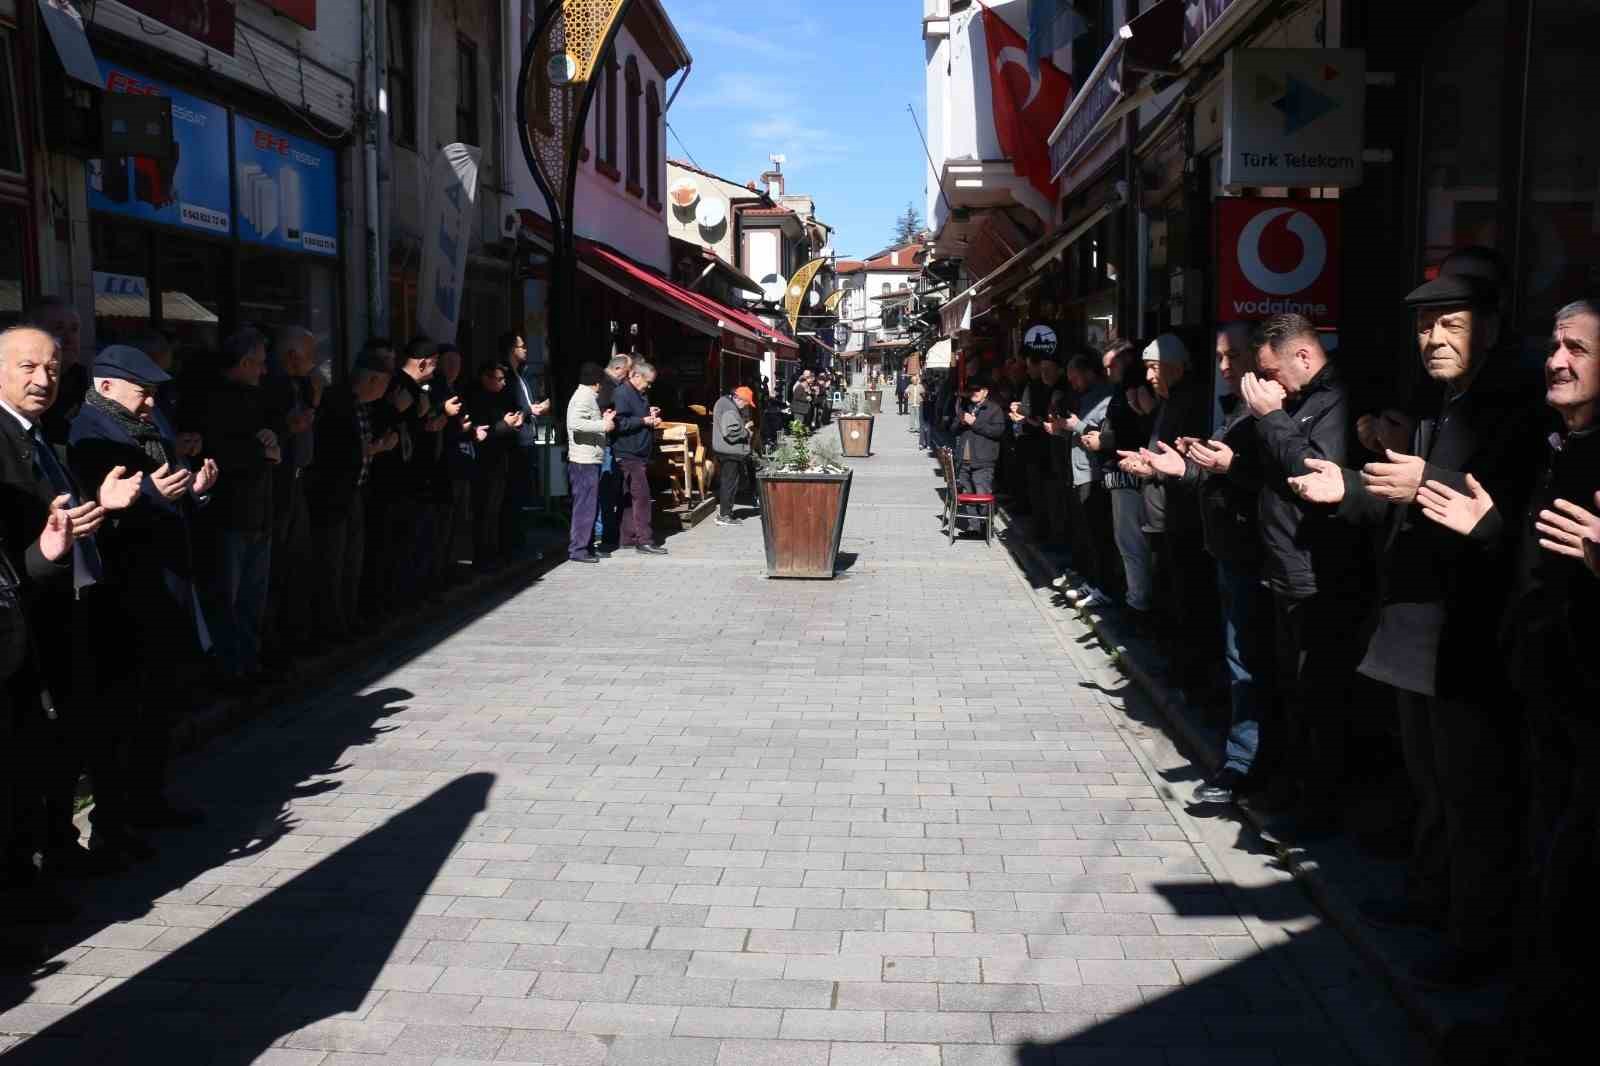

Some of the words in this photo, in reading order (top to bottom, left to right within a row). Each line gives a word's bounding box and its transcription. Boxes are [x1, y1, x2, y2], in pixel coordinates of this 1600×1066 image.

[1241, 152, 1277, 168] Türk
[1284, 153, 1355, 169] Telekom
[1233, 297, 1328, 315] vodafone
